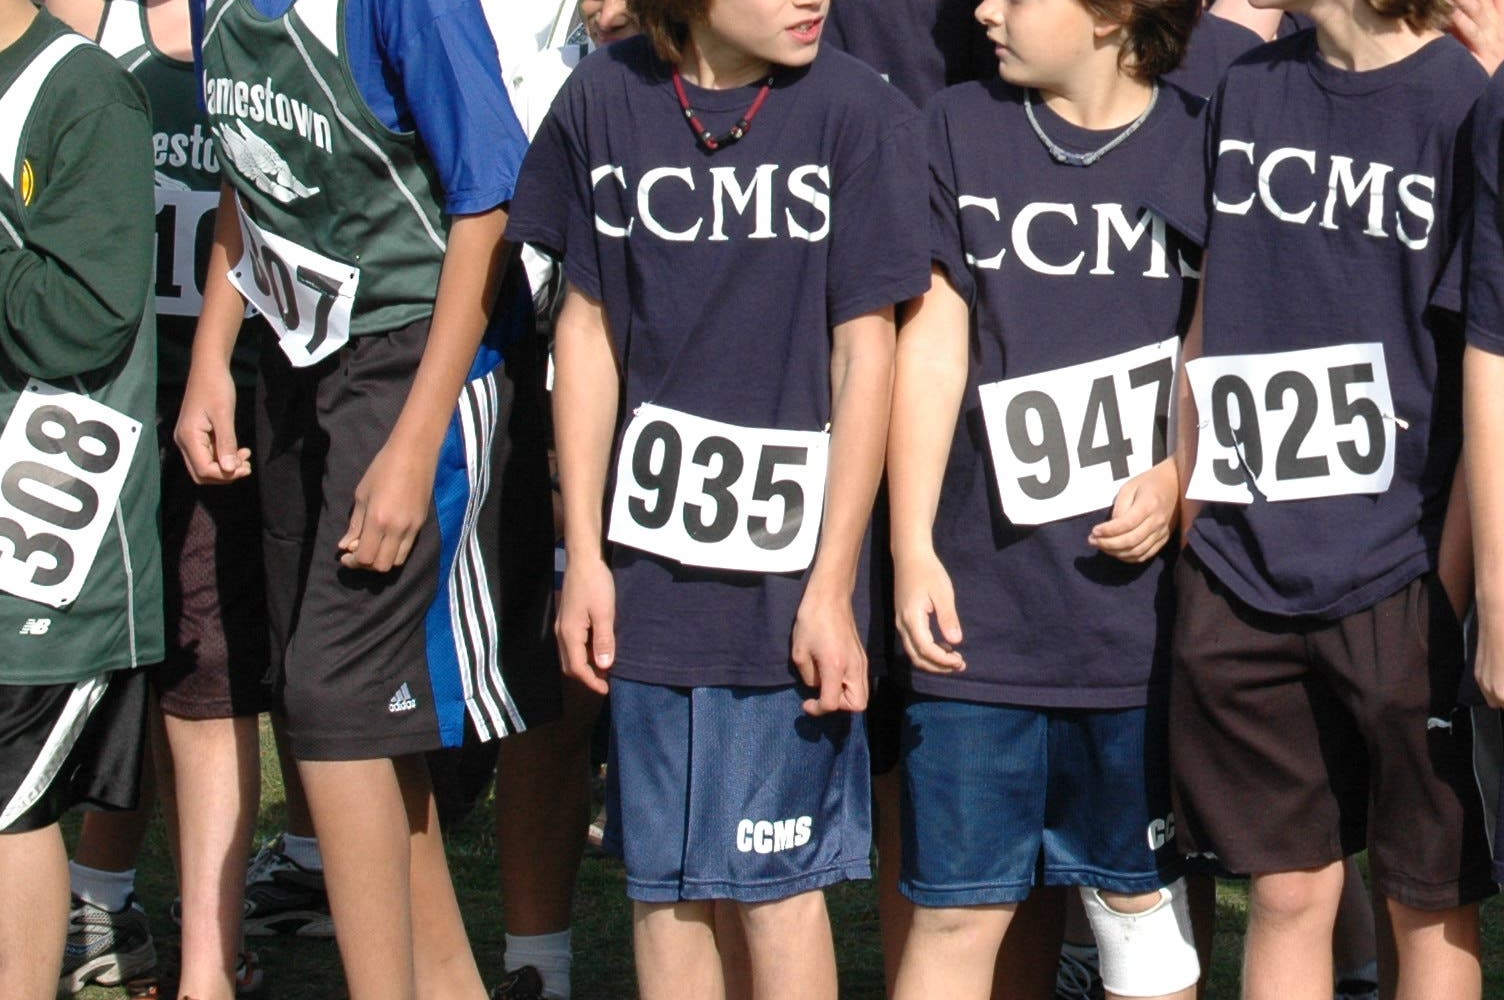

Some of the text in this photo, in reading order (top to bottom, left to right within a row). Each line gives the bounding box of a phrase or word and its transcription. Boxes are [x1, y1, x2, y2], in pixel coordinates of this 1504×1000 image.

[591, 164, 830, 242] CCMS
[957, 194, 1200, 279] CCM
[1212, 140, 1437, 250] CCMS
[1005, 356, 1176, 501] 947
[1210, 362, 1387, 487] 925
[0, 405, 121, 587] 308
[628, 419, 809, 551] 935
[389, 698, 416, 712] adidas
[736, 816, 812, 854] CCMS
